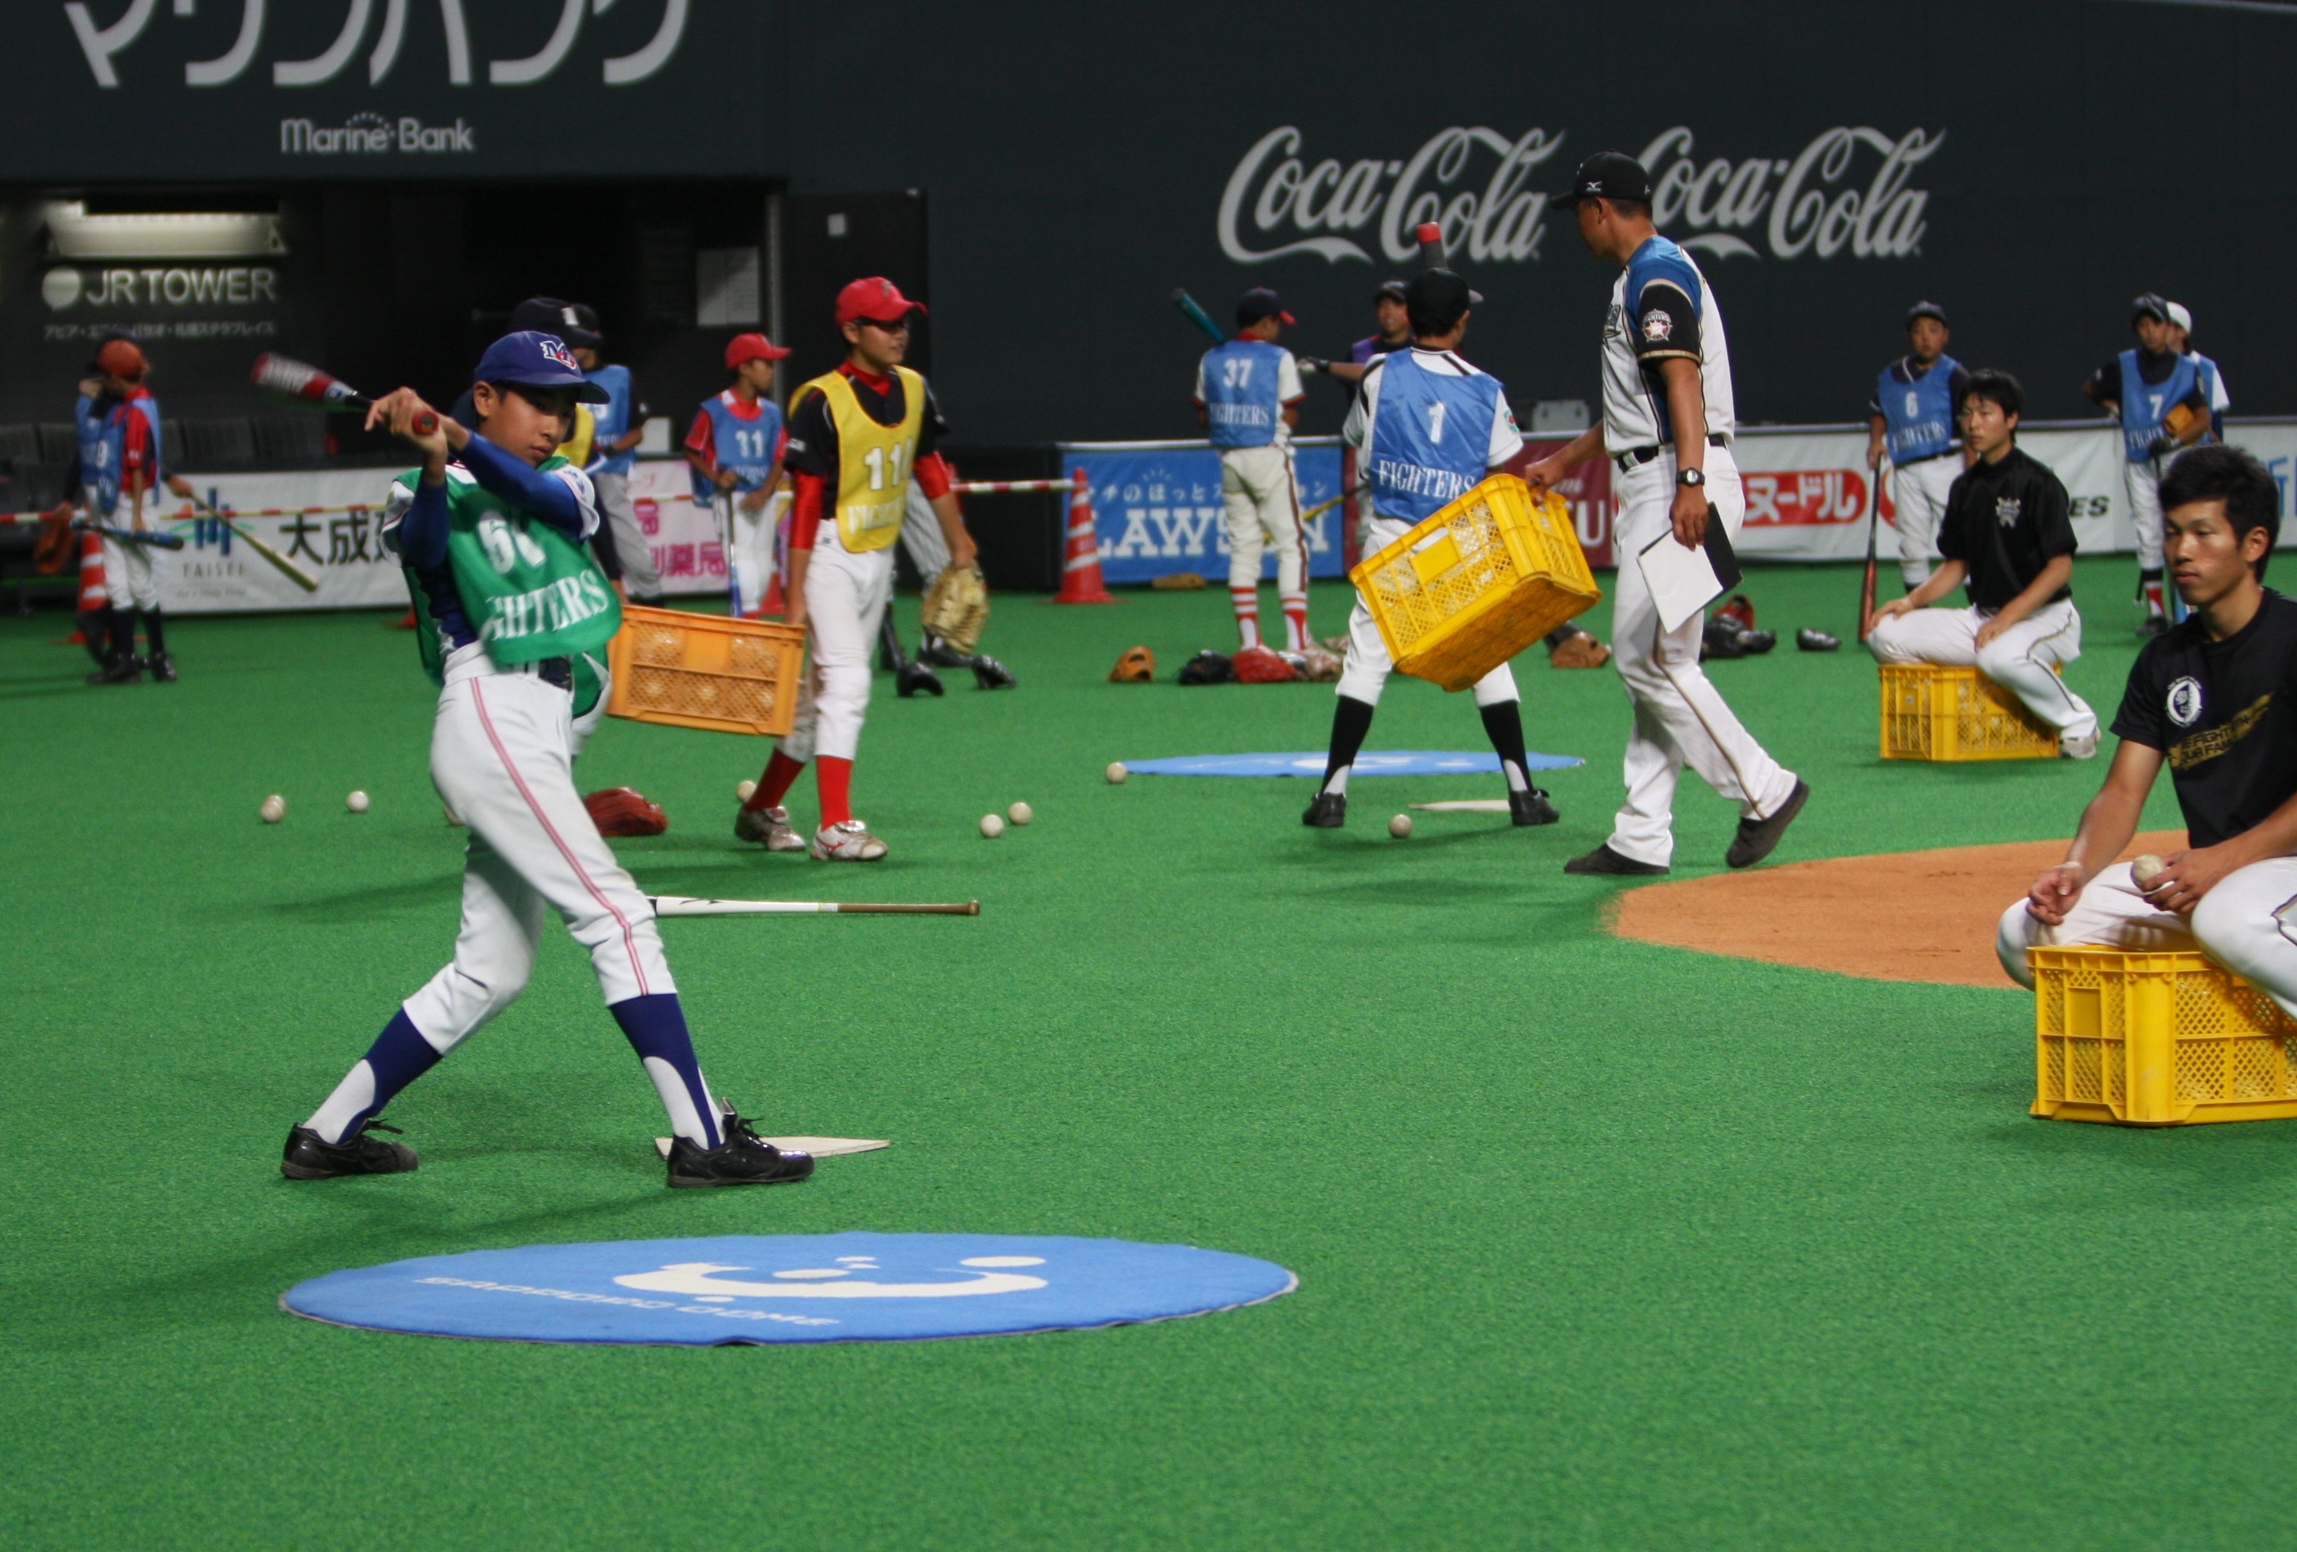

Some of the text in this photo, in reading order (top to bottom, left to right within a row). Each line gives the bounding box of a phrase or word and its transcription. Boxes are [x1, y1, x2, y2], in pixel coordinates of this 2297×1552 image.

[280, 117, 476, 154] Marine Bank
[1217, 125, 1566, 264] Coca-Cola
[86, 268, 276, 305] JR TOWER
[1222, 357, 1253, 388] 37
[1428, 401, 1445, 445] 1
[2148, 394, 2164, 421] 7
[1378, 459, 1476, 500] FIGHTERS
